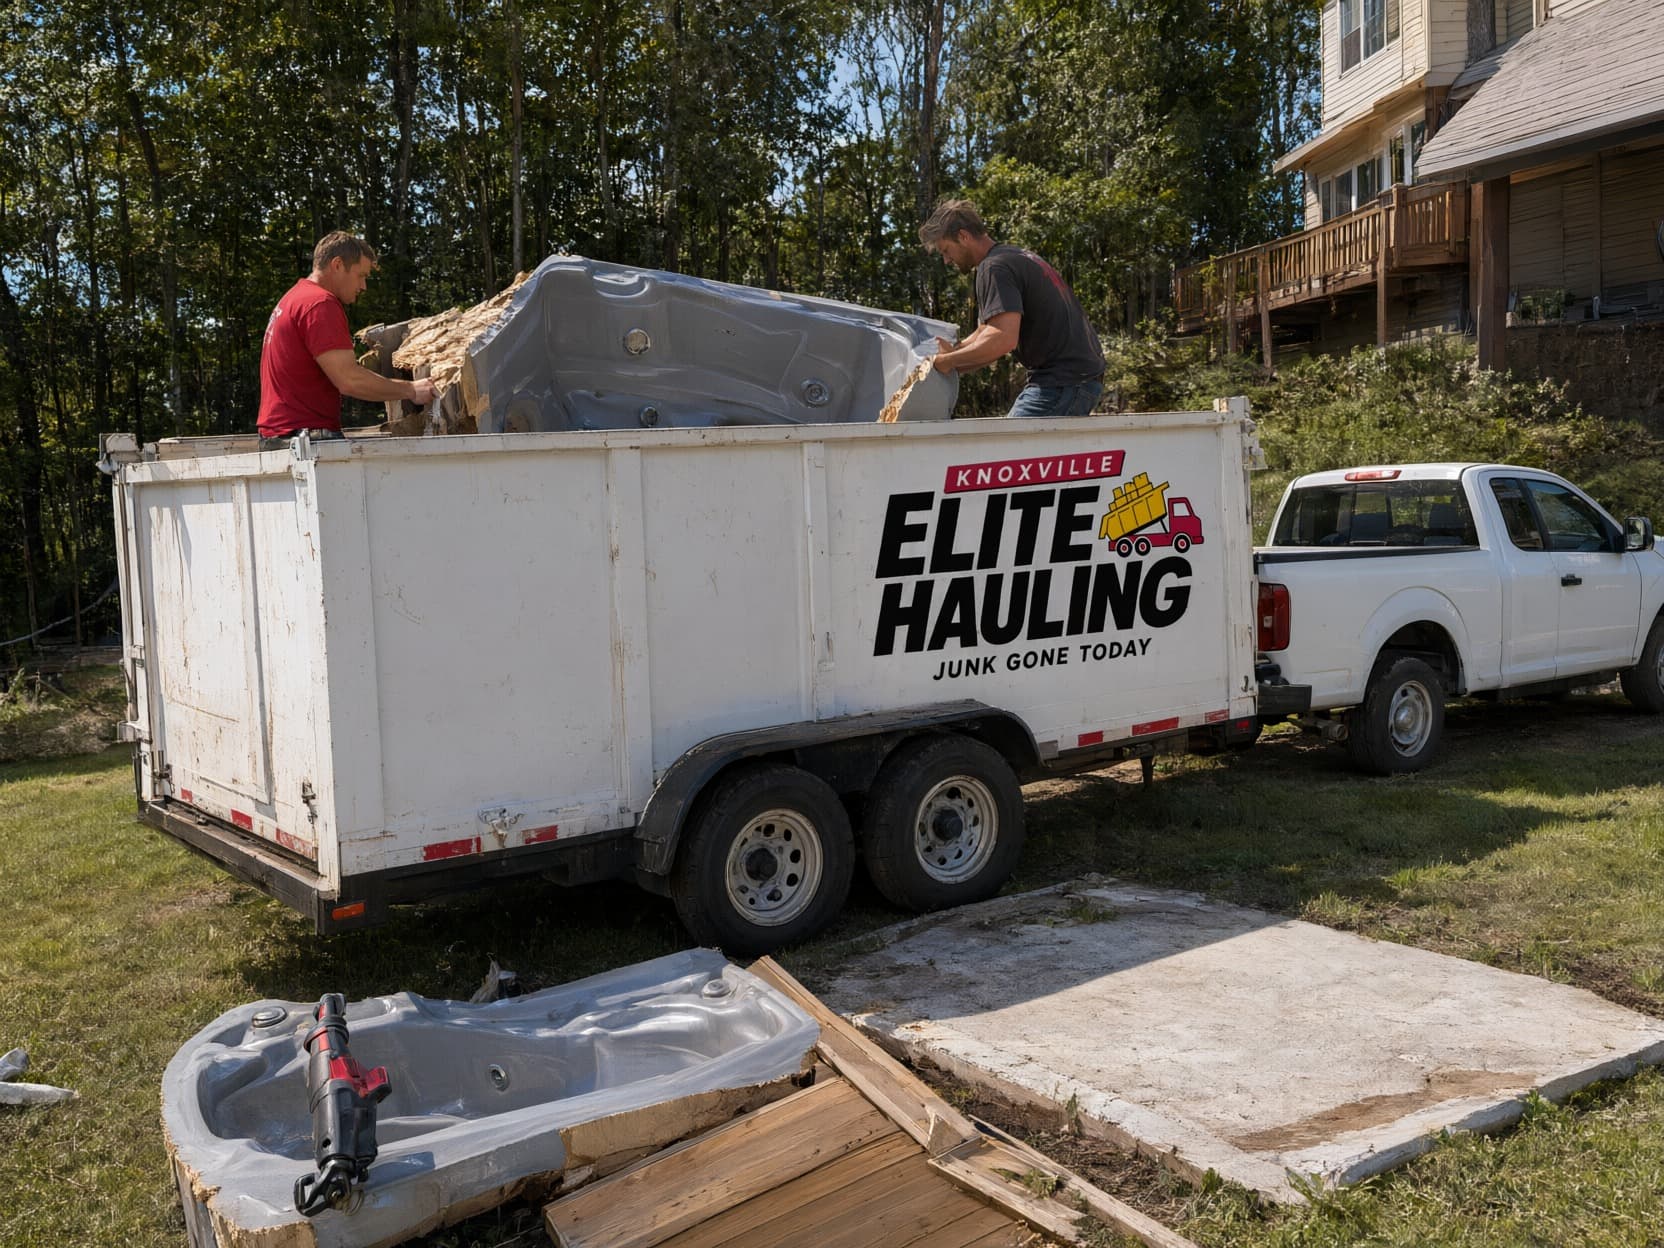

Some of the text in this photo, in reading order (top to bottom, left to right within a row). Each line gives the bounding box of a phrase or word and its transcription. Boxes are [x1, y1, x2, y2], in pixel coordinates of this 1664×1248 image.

[956, 455, 1113, 486] KNOXVILLE
[875, 485, 1100, 579] ELITE
[873, 556, 1192, 656] HAULING
[932, 638, 1152, 681] JUNK GONE TODAY
